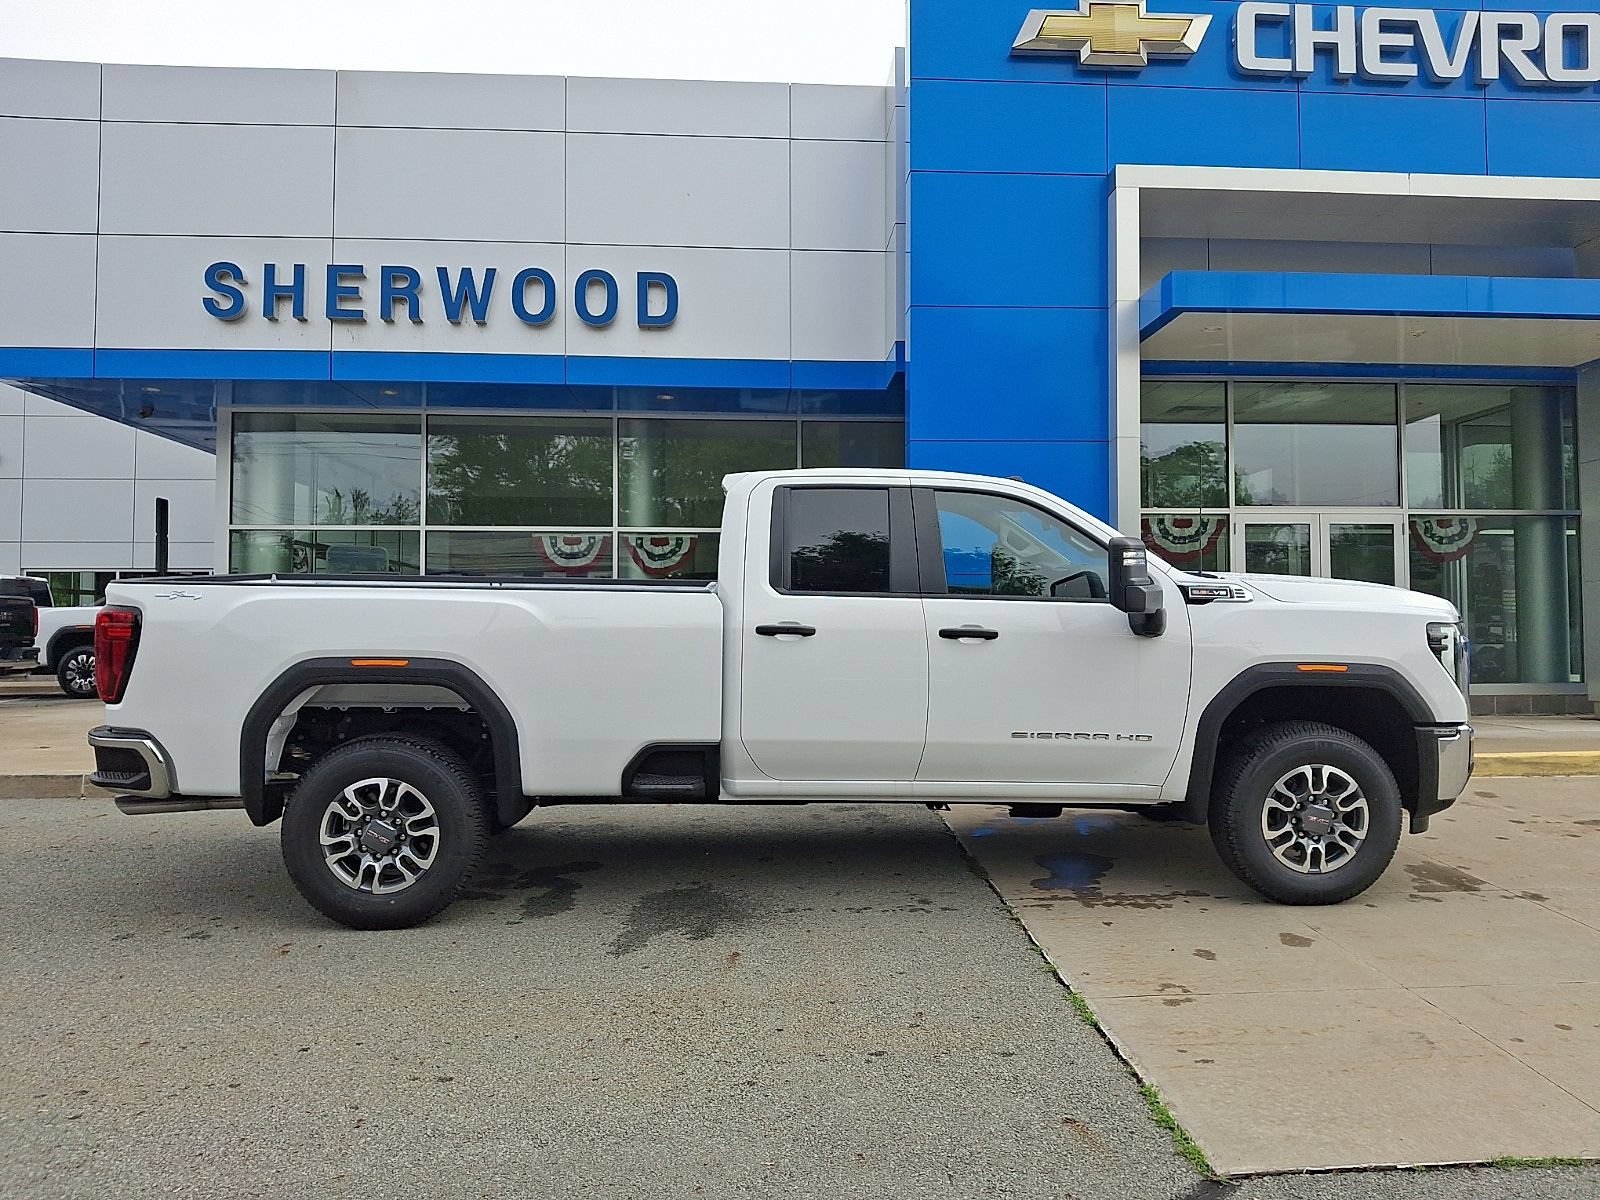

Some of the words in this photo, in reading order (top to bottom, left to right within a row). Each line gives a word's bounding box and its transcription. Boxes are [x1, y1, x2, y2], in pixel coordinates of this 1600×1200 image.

[1236, 1, 1600, 84] CHEVRO
[202, 261, 680, 328] SHERWOOD
[1011, 732, 1110, 740] SIERRA
